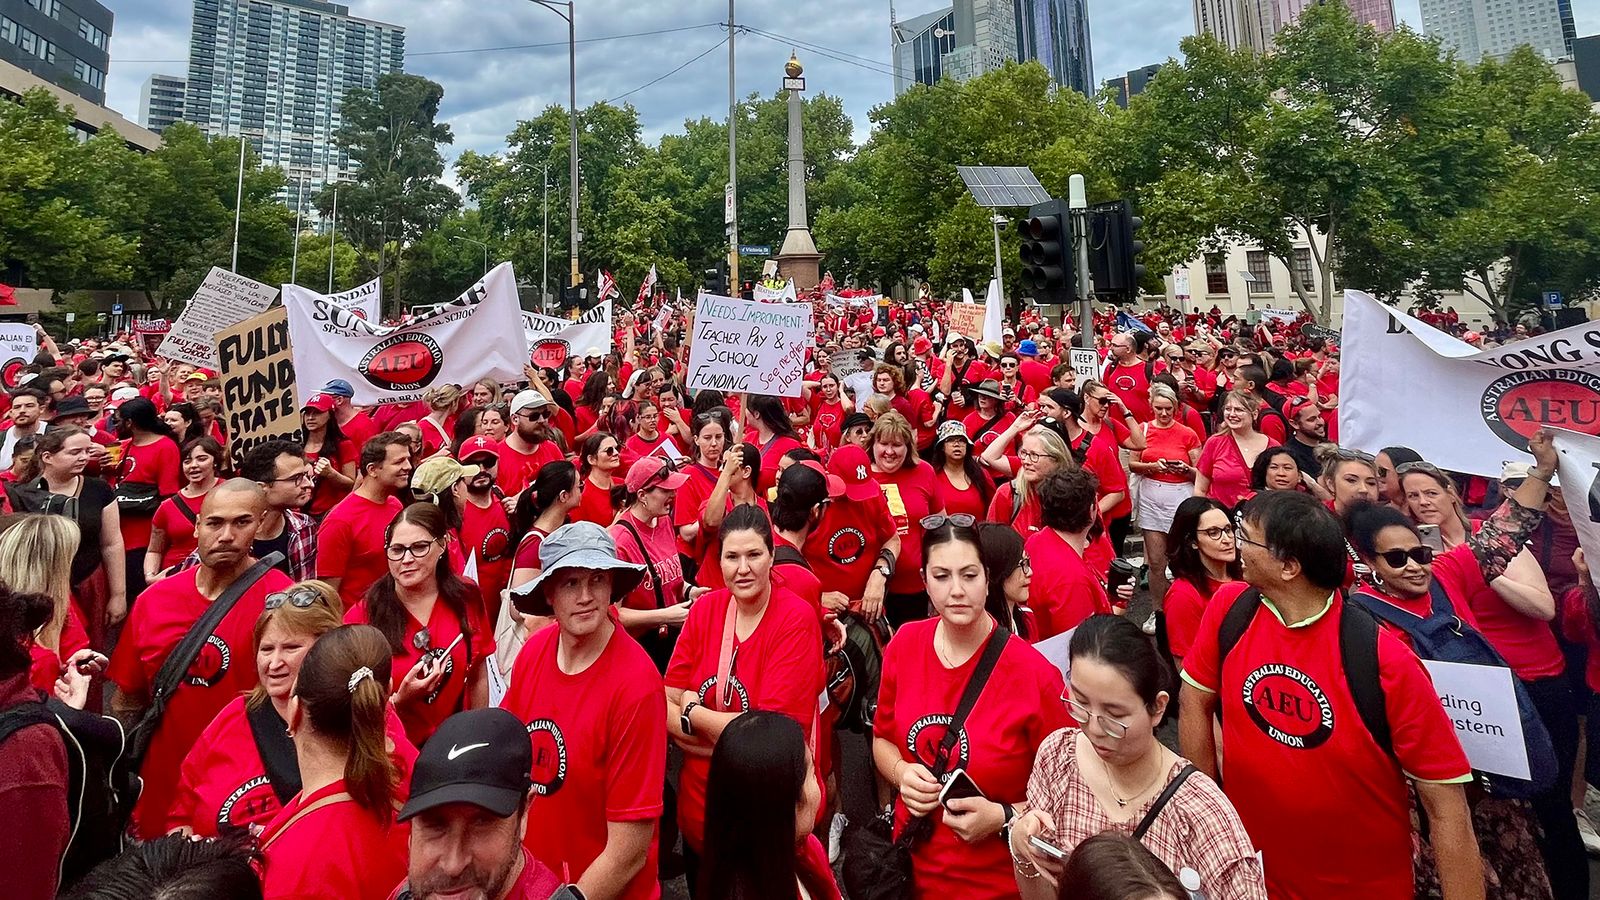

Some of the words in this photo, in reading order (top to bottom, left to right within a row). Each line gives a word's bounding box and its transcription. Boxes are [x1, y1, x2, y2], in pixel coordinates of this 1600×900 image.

[699, 298, 738, 321] NEEDS
[738, 303, 804, 329] IMPROVEMENT:
[0, 334, 23, 342] ALIAN
[167, 335, 192, 349] FULLY
[191, 342, 211, 352] FUND
[218, 319, 289, 374] FULLY
[406, 333, 442, 365] EDUCATION
[698, 321, 741, 346] TEACHER
[746, 326, 768, 348] PAY
[773, 331, 785, 351] &
[178, 346, 212, 360] SCHOOLS
[373, 350, 427, 373] AEU
[533, 348, 566, 361] AEU
[706, 343, 759, 368] SCHOOL
[759, 367, 780, 391] See
[779, 353, 791, 370] me
[788, 340, 806, 361] after
[1074, 354, 1093, 364] KEEP
[224, 358, 296, 411] FUND
[690, 365, 751, 391] FUNDING
[1075, 366, 1093, 376] LEFT
[390, 381, 421, 390] UNION
[1482, 369, 1552, 422] AUSTRALIAN
[1556, 369, 1600, 394] EDUC
[230, 388, 294, 441] STATE
[1504, 397, 1600, 425] AEU
[1255, 685, 1315, 723] AEU
[1284, 666, 1333, 729] EDUCATION
[1439, 693, 1483, 717] ding
[907, 715, 946, 752] AUSTRALIAN
[1268, 725, 1305, 748] UNION
[1450, 718, 1505, 738] stem
[218, 775, 271, 824] AUSTRALIA
